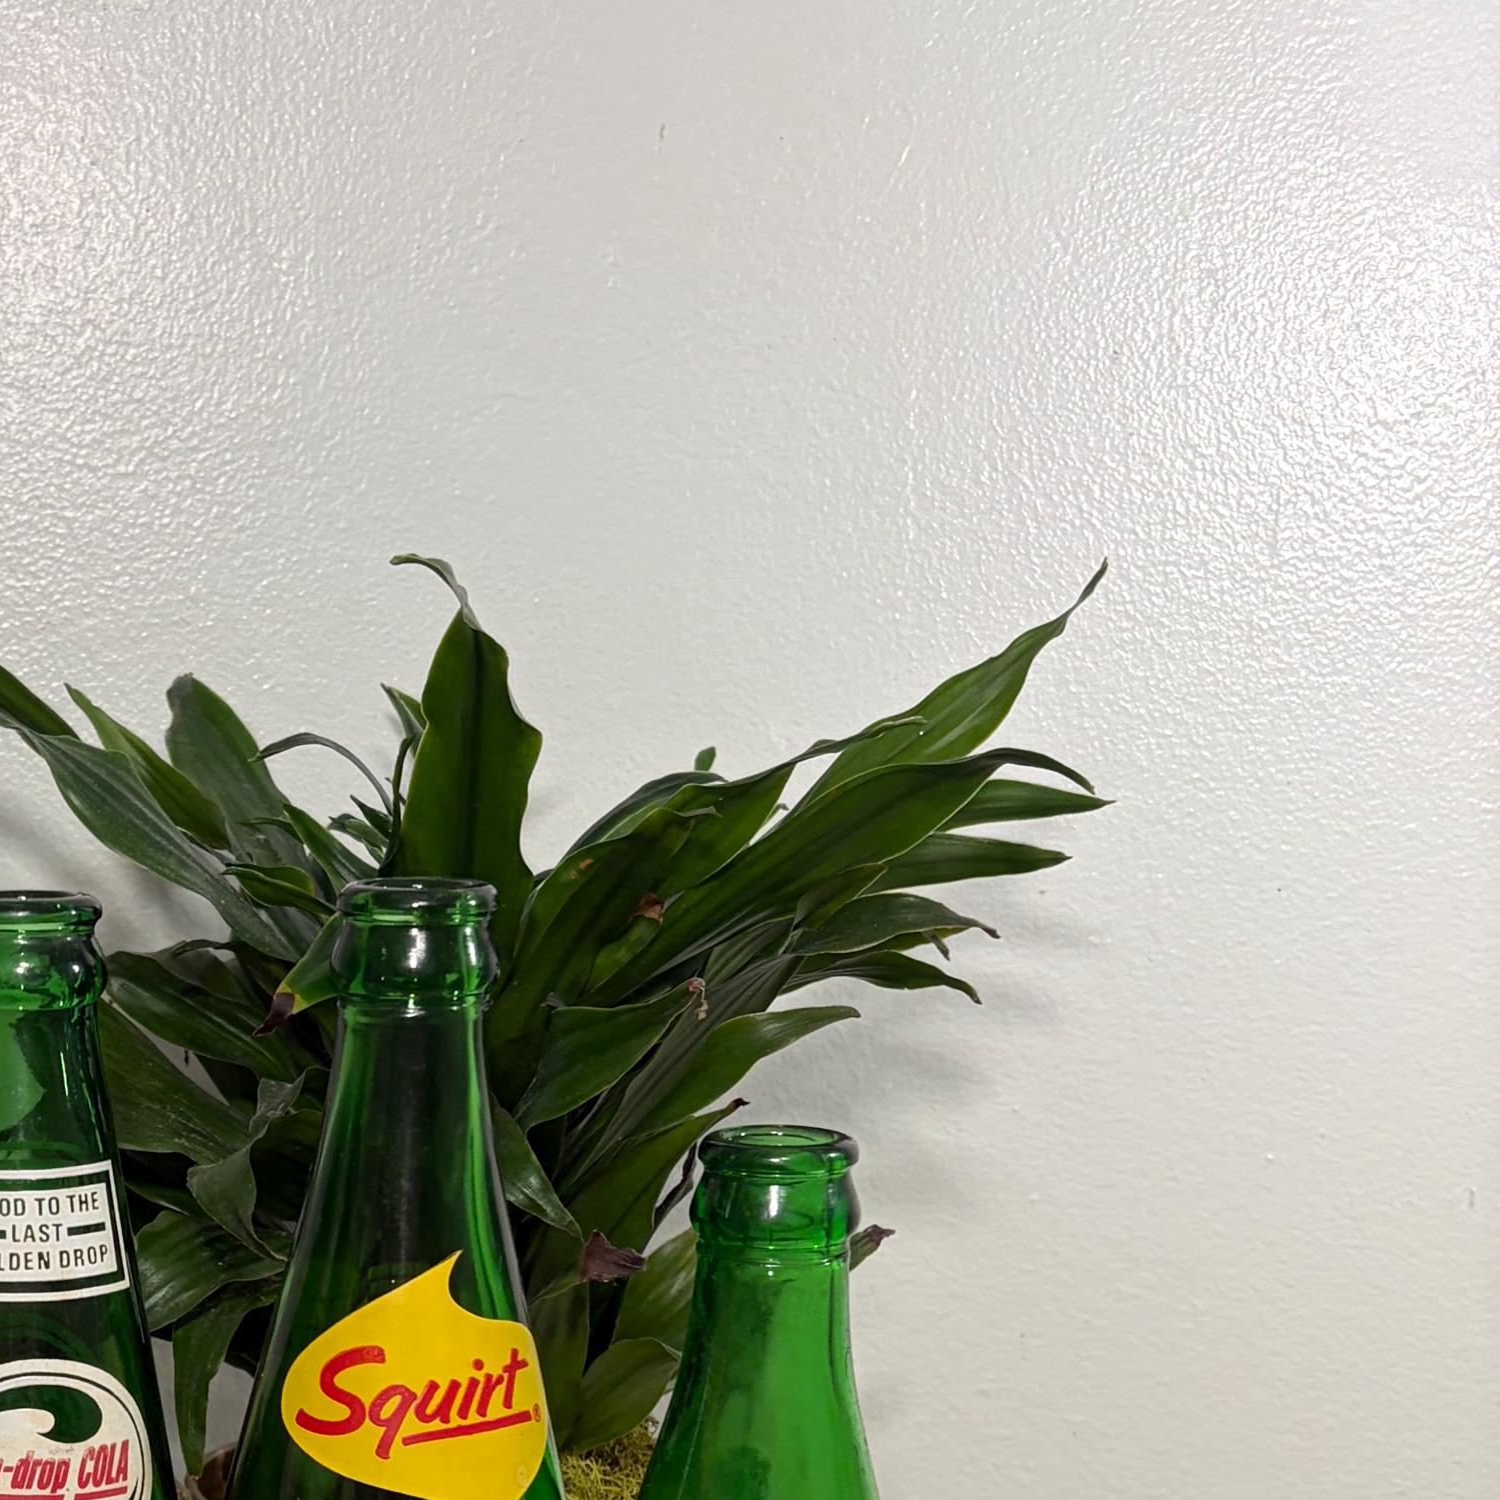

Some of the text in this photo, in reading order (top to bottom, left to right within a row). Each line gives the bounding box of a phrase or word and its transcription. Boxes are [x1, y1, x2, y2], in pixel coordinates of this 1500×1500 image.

[34, 1196, 60, 1217] TO
[66, 1191, 100, 1213] THE
[11, 1223, 64, 1244] LAST
[59, 1244, 109, 1269] DROP
[294, 1344, 529, 1461] Squirt
[76, 1439, 130, 1490] COLA
